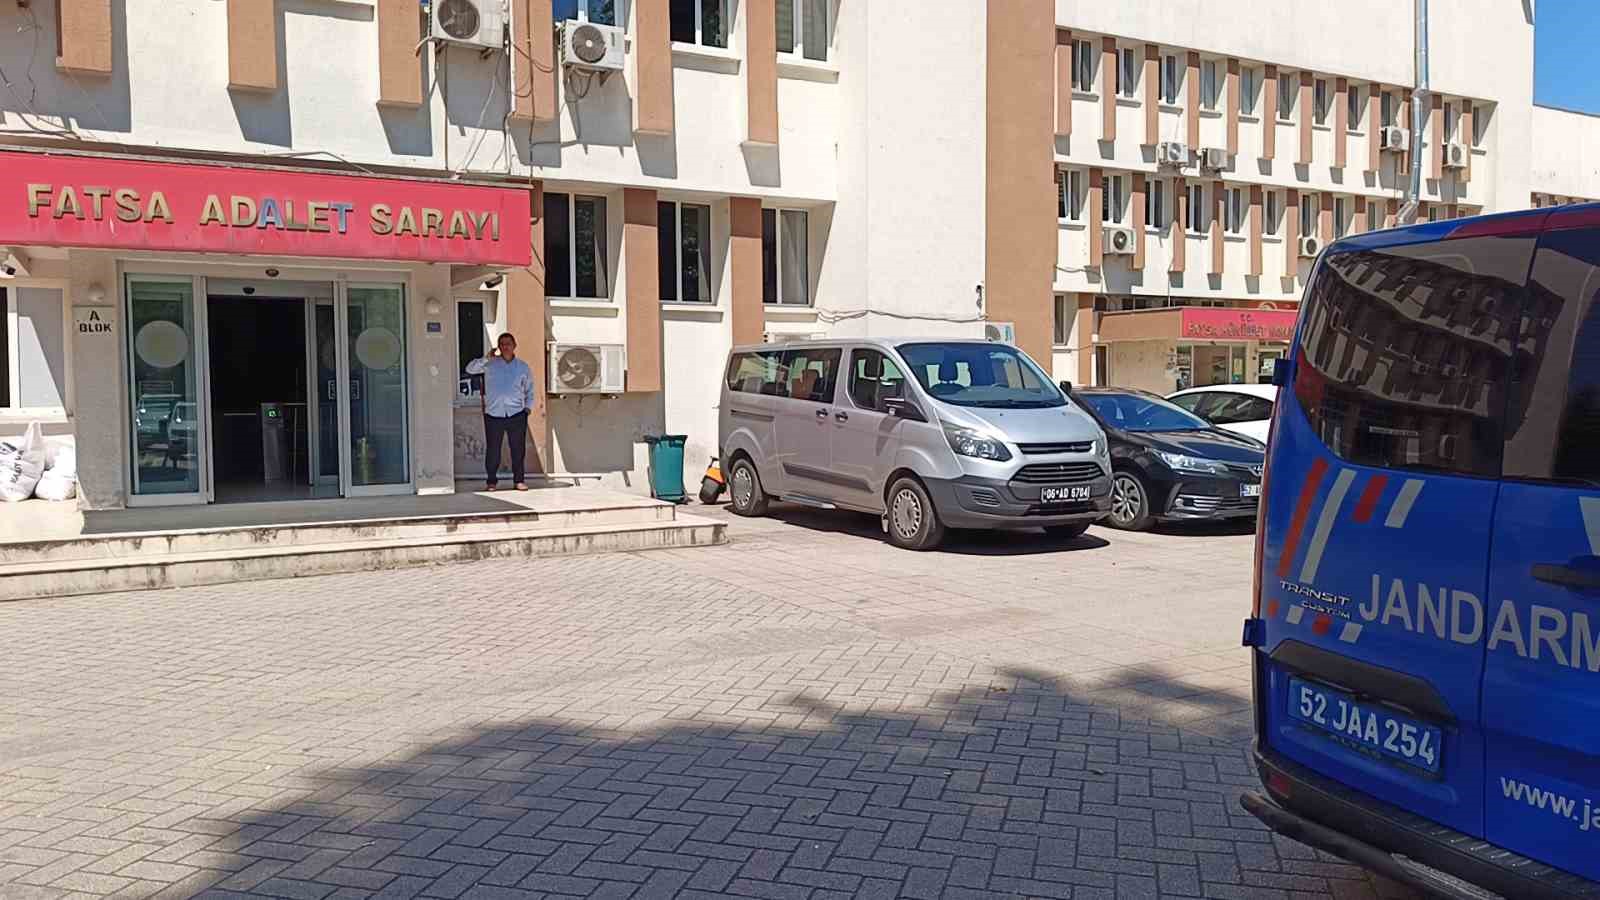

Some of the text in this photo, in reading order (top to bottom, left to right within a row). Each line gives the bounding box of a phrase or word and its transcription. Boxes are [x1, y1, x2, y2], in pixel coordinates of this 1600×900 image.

[27, 183, 501, 241] FATSA ADALET SARAYI
[79, 322, 112, 333] BLOK
[90, 310, 100, 321] A
[1280, 580, 1350, 606] TRANSIT
[1300, 686, 1327, 725] 52
[1333, 700, 1379, 745] JAA
[1383, 719, 1435, 765] 254
